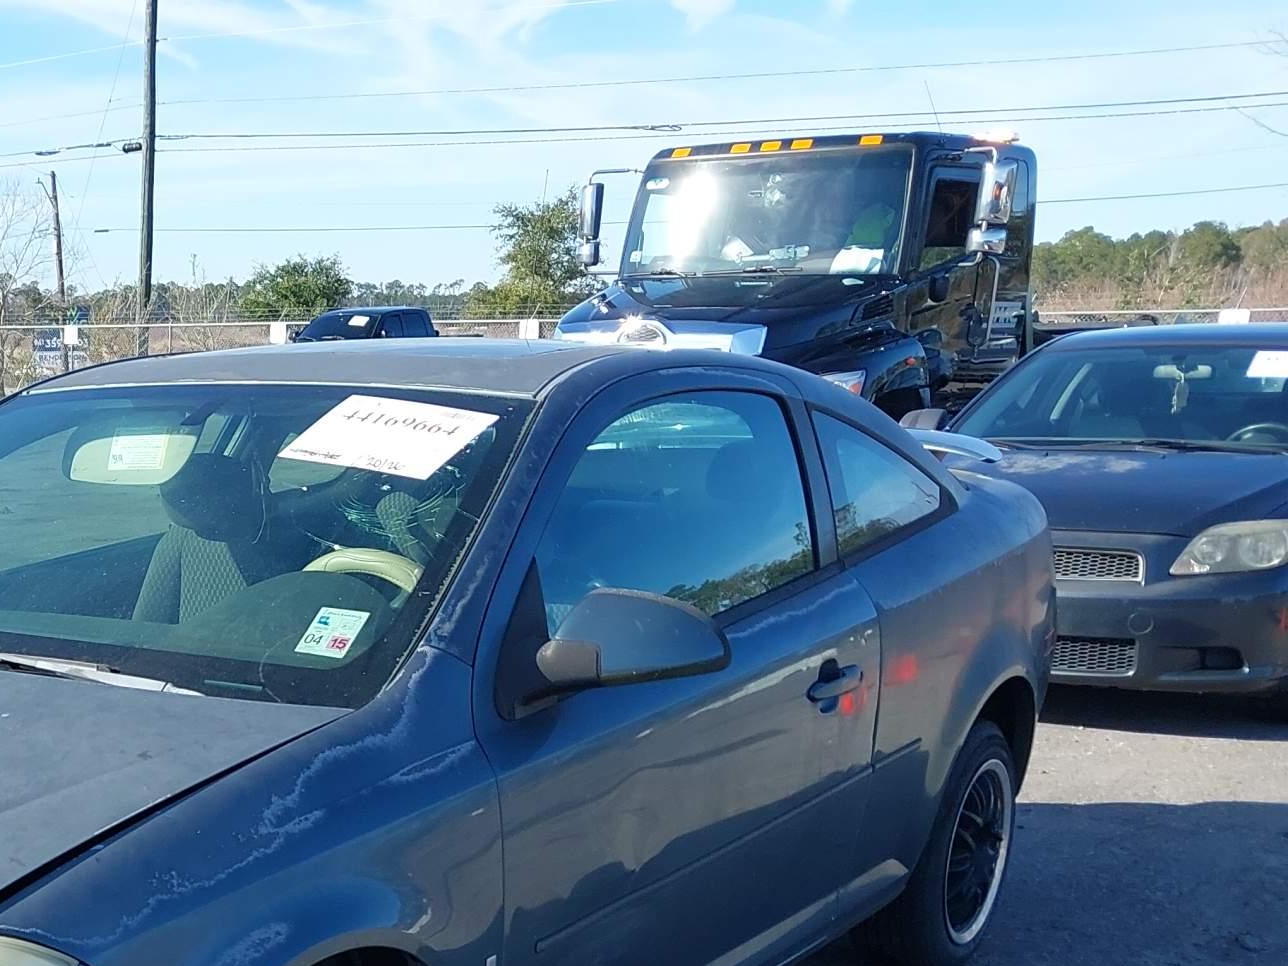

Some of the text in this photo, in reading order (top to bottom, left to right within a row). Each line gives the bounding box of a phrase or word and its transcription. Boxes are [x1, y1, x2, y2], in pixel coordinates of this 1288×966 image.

[343, 410, 461, 436] 44169664
[304, 633, 349, 649] 04 15
